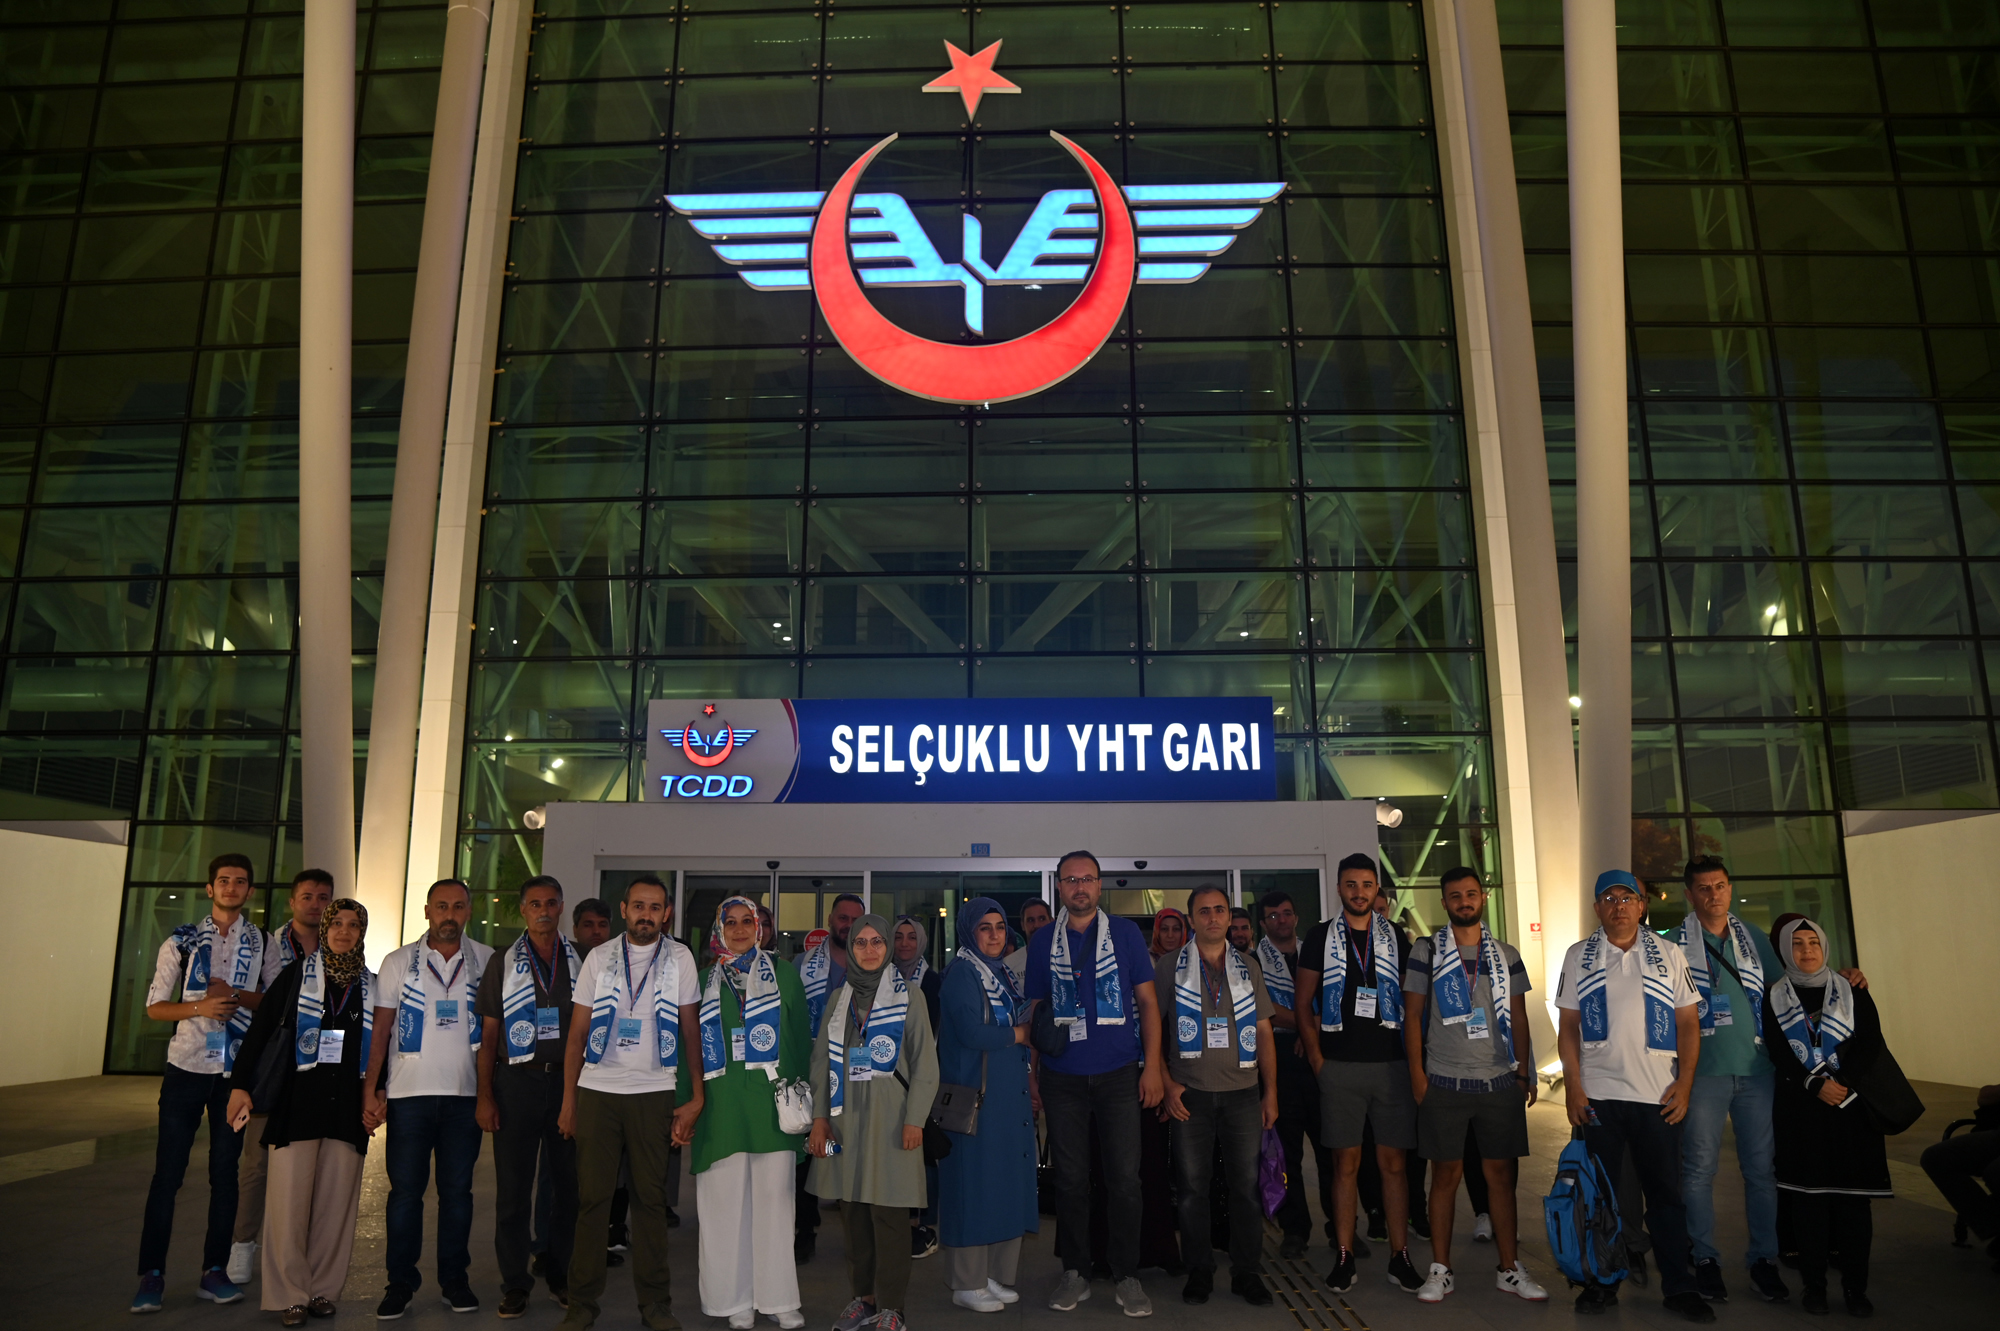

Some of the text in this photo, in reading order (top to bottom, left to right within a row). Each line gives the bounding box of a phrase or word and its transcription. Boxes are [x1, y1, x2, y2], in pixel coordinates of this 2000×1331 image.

[829, 722, 1260, 785] SELÇUKLU YHT GARI
[660, 774, 754, 798] TCDD
